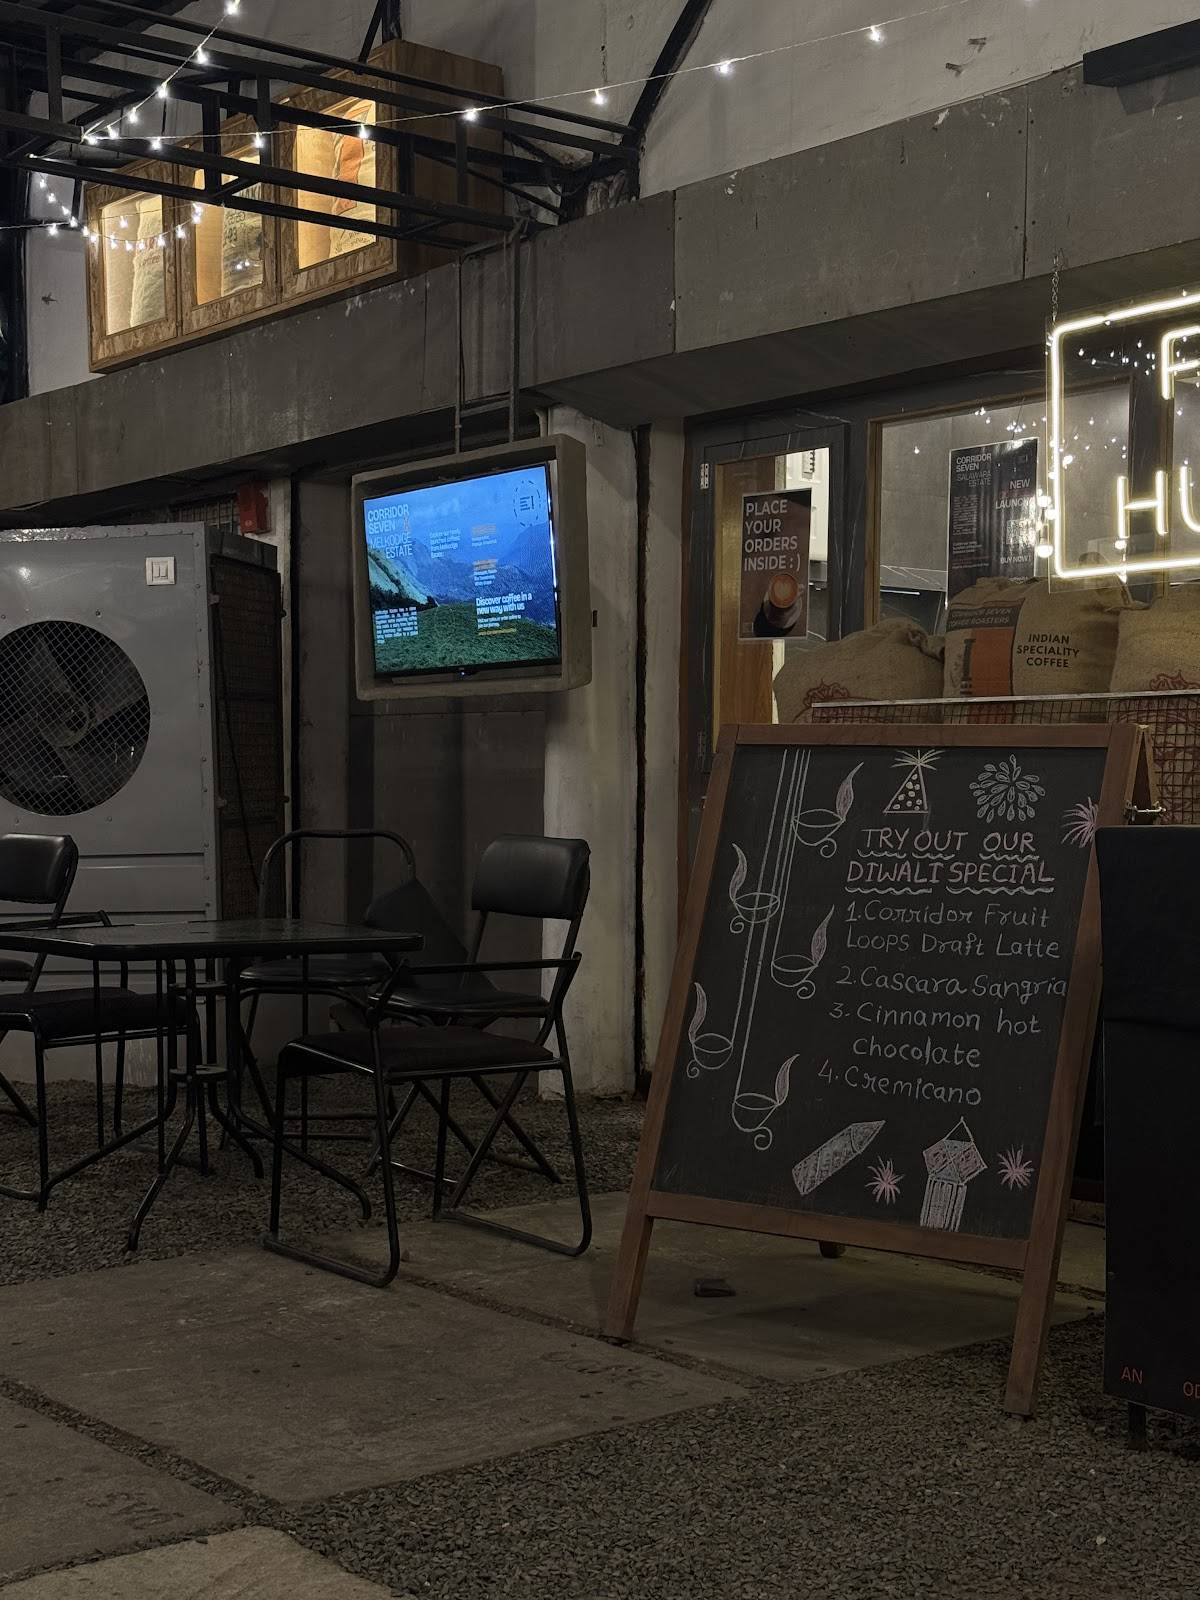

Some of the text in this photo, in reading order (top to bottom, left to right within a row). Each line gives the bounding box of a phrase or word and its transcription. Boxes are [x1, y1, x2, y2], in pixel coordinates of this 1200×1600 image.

[956, 453, 992, 465] CORRIDOR
[956, 462, 980, 473] SEVEN
[969, 477, 992, 488] ESTATE
[1009, 479, 1031, 490] NEW
[368, 504, 409, 521] CORRIDOR
[745, 499, 788, 517] PLACE
[369, 520, 396, 535] SEVEN
[744, 518, 782, 535] YOUR
[386, 543, 413, 559] ESTATE
[744, 536, 799, 553] ORDERS
[744, 555, 786, 572] INSIDE
[476, 596, 501, 606] Discover
[501, 593, 520, 605] coffee
[521, 591, 527, 602] in
[517, 602, 525, 611] us
[1028, 633, 1070, 645] INDIAN
[1016, 645, 1080, 658] SPECIALITY
[1026, 656, 1070, 669] COFFEE
[861, 827, 1036, 853] TRY OUT OUR
[847, 861, 1055, 884] DIWALI SPECIAL
[984, 903, 1050, 928] Fruit
[921, 932, 985, 956] Draft
[996, 934, 1061, 959] Latte
[971, 974, 1067, 1005] Sangria
[856, 1002, 981, 1031] Cinnamon
[996, 1008, 1041, 1036] hot
[844, 1066, 982, 1105] Cremicano
[1119, 1366, 1144, 1385] AN
